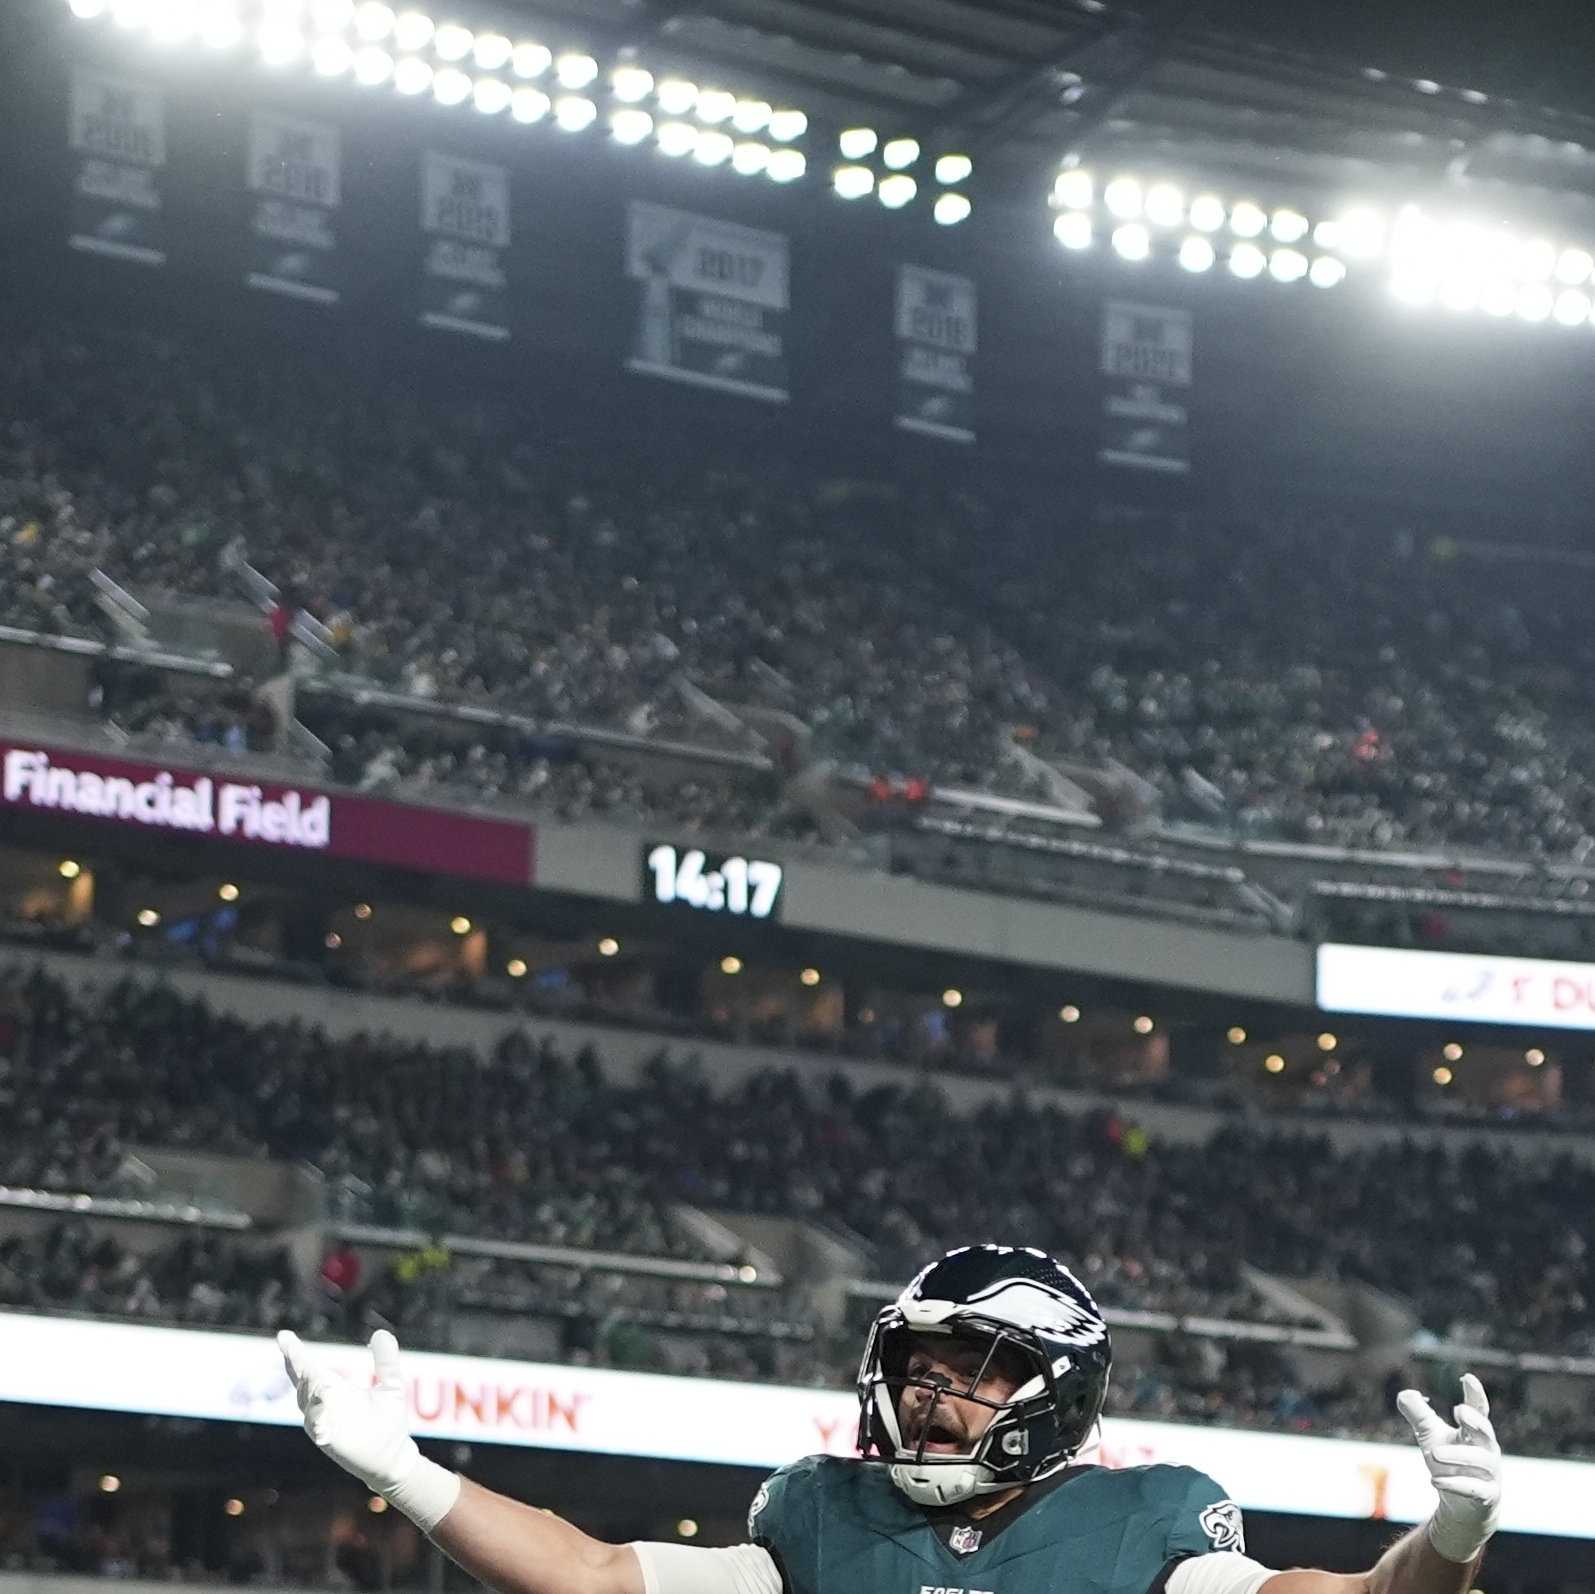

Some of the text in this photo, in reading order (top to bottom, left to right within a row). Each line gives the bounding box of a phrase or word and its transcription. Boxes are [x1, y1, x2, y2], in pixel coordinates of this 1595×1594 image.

[4, 750, 213, 832] Financial
[219, 785, 331, 849] Field
[648, 844, 783, 918] 14:17
